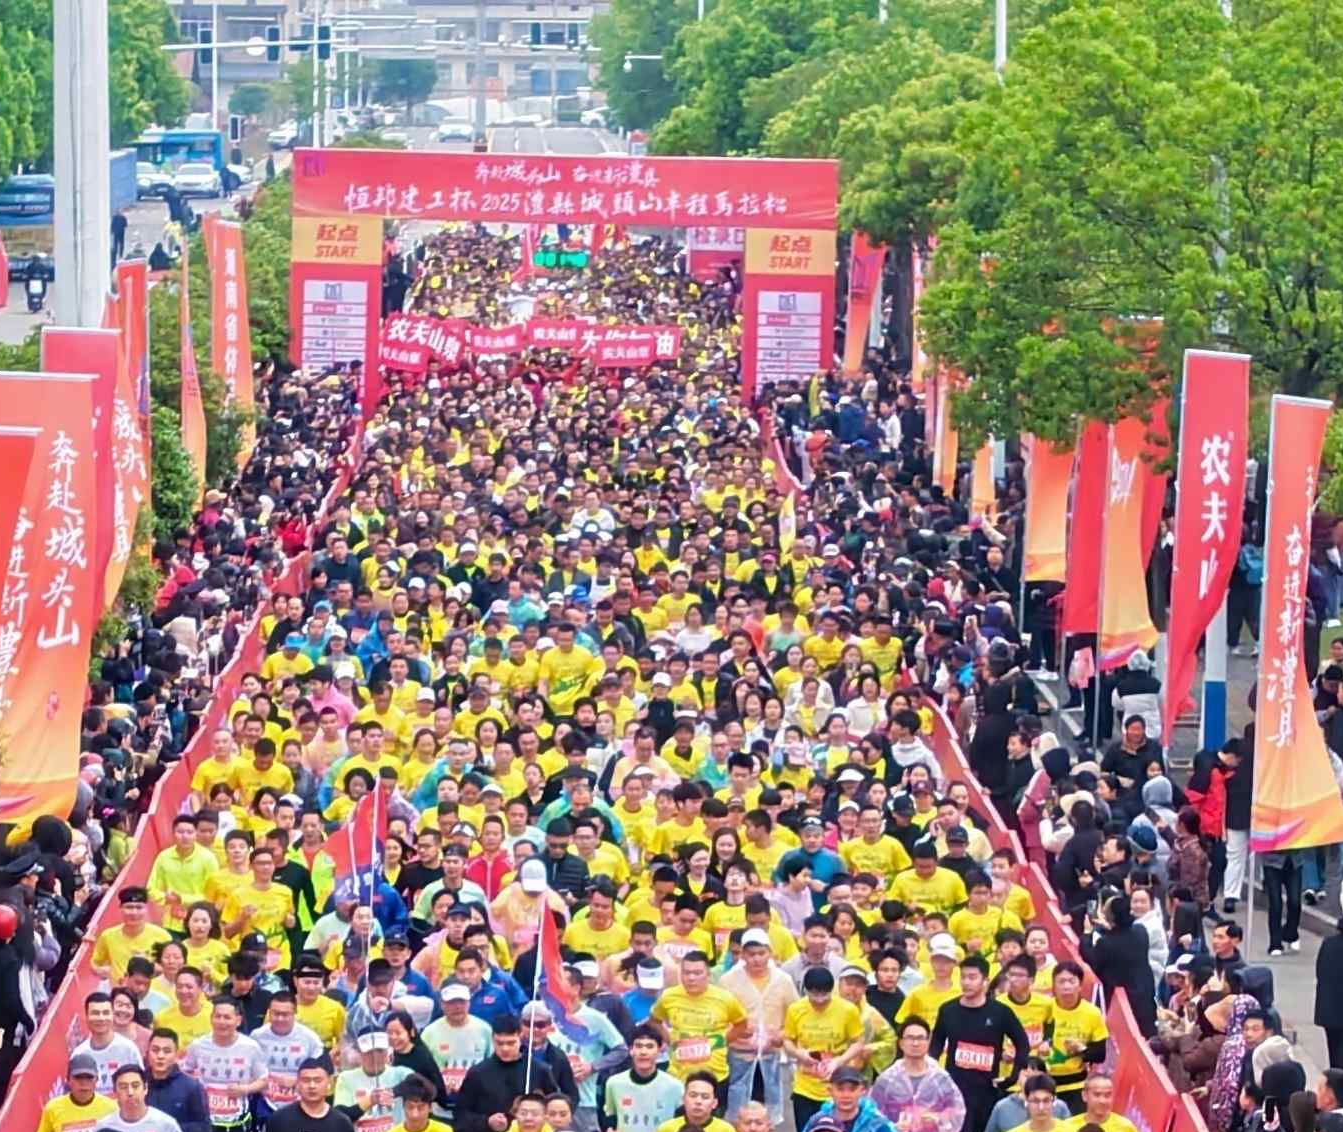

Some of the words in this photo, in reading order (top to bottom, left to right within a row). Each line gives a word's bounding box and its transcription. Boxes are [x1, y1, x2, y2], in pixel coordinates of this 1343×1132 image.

[316, 224, 359, 241] 起点
[315, 246, 359, 258] START
[770, 235, 812, 253] 起点
[769, 257, 812, 270] START
[36, 430, 88, 649] 奔赴城头山
[1266, 525, 1306, 748] 奋进新澧县
